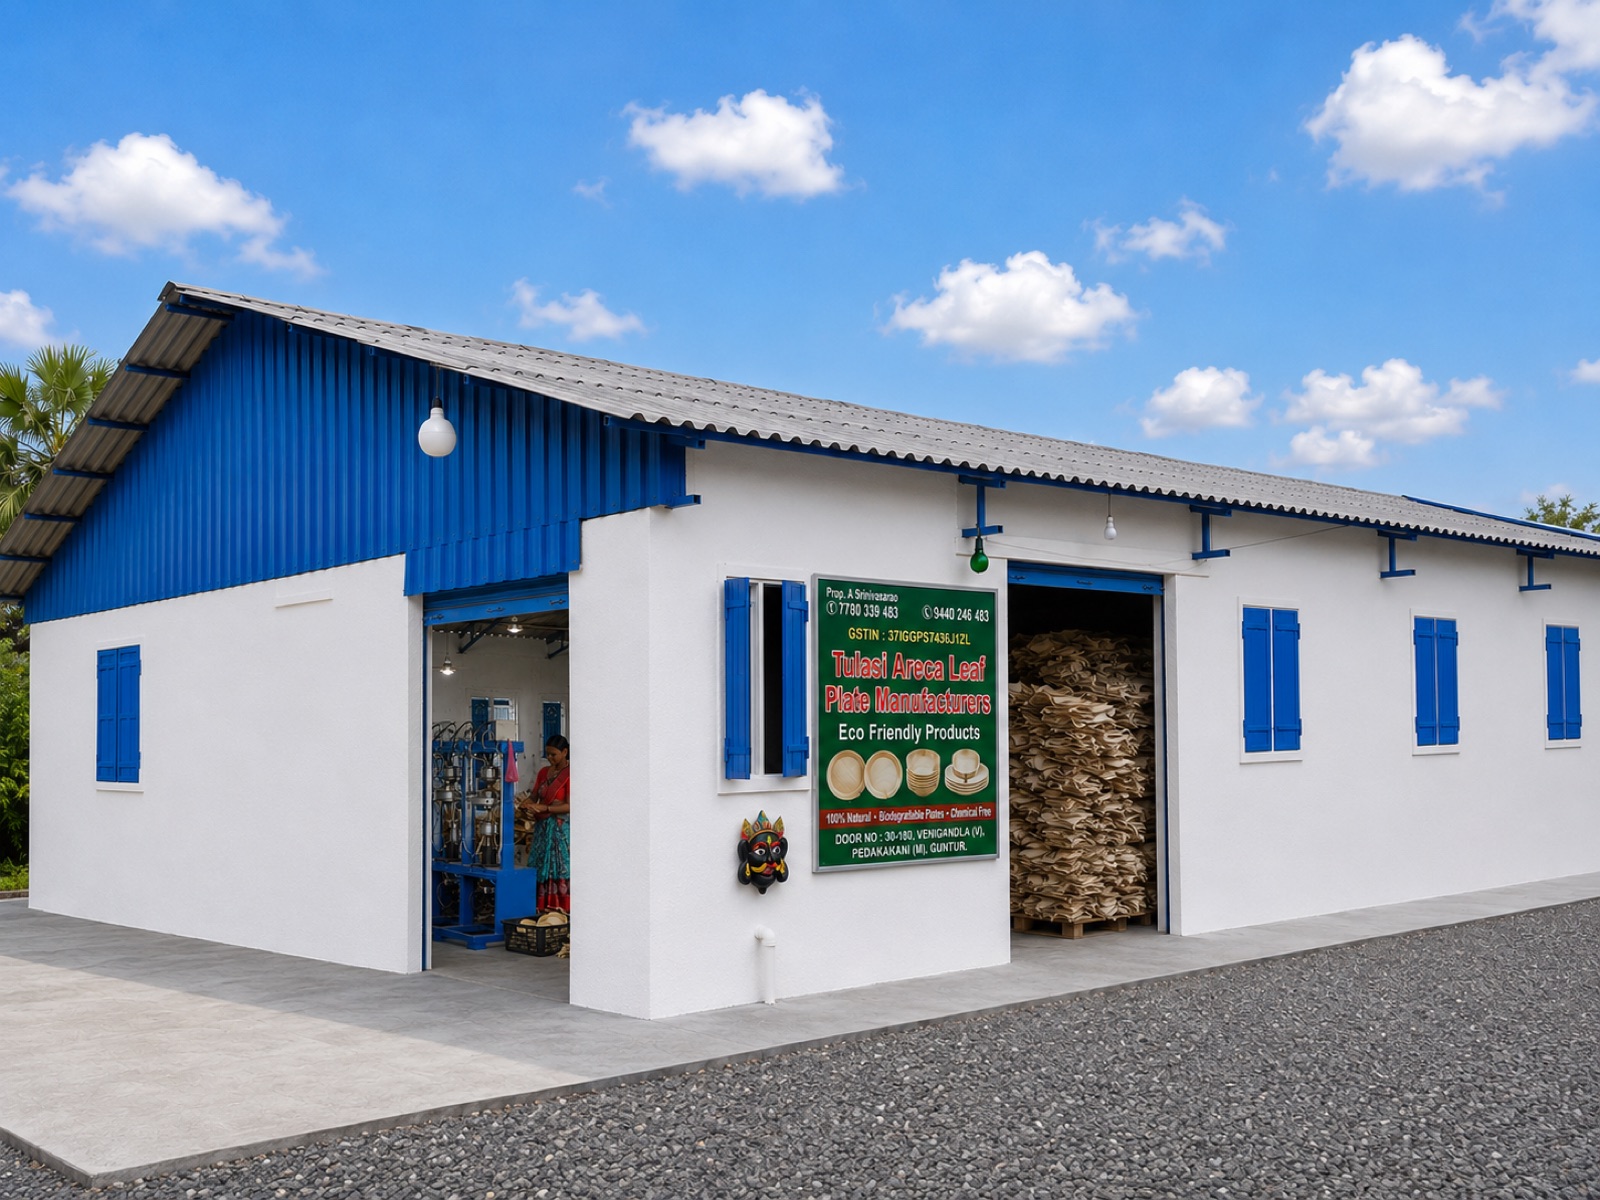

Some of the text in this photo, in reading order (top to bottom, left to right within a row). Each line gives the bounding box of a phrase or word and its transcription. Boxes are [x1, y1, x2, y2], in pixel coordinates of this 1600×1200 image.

[826, 587, 846, 600] Prop.
[847, 588, 854, 599] A
[838, 602, 899, 619] 7780 339 483
[933, 606, 990, 622] 9440 246 483
[848, 627, 879, 641] GSTIN
[831, 649, 987, 682] Tulasi Areca Leaf
[825, 685, 991, 715] Plate Manufacturers
[838, 723, 981, 744] Eco Friendly Products
[826, 812, 846, 825] 100%
[846, 811, 871, 824] Natural
[978, 805, 992, 818] Free
[835, 832, 863, 845] DOOR
[864, 832, 878, 844] NO
[916, 828, 970, 840] VENIGANDLA
[852, 845, 910, 859] PEDAKAKANI
[930, 841, 968, 853] GUNTUR.
